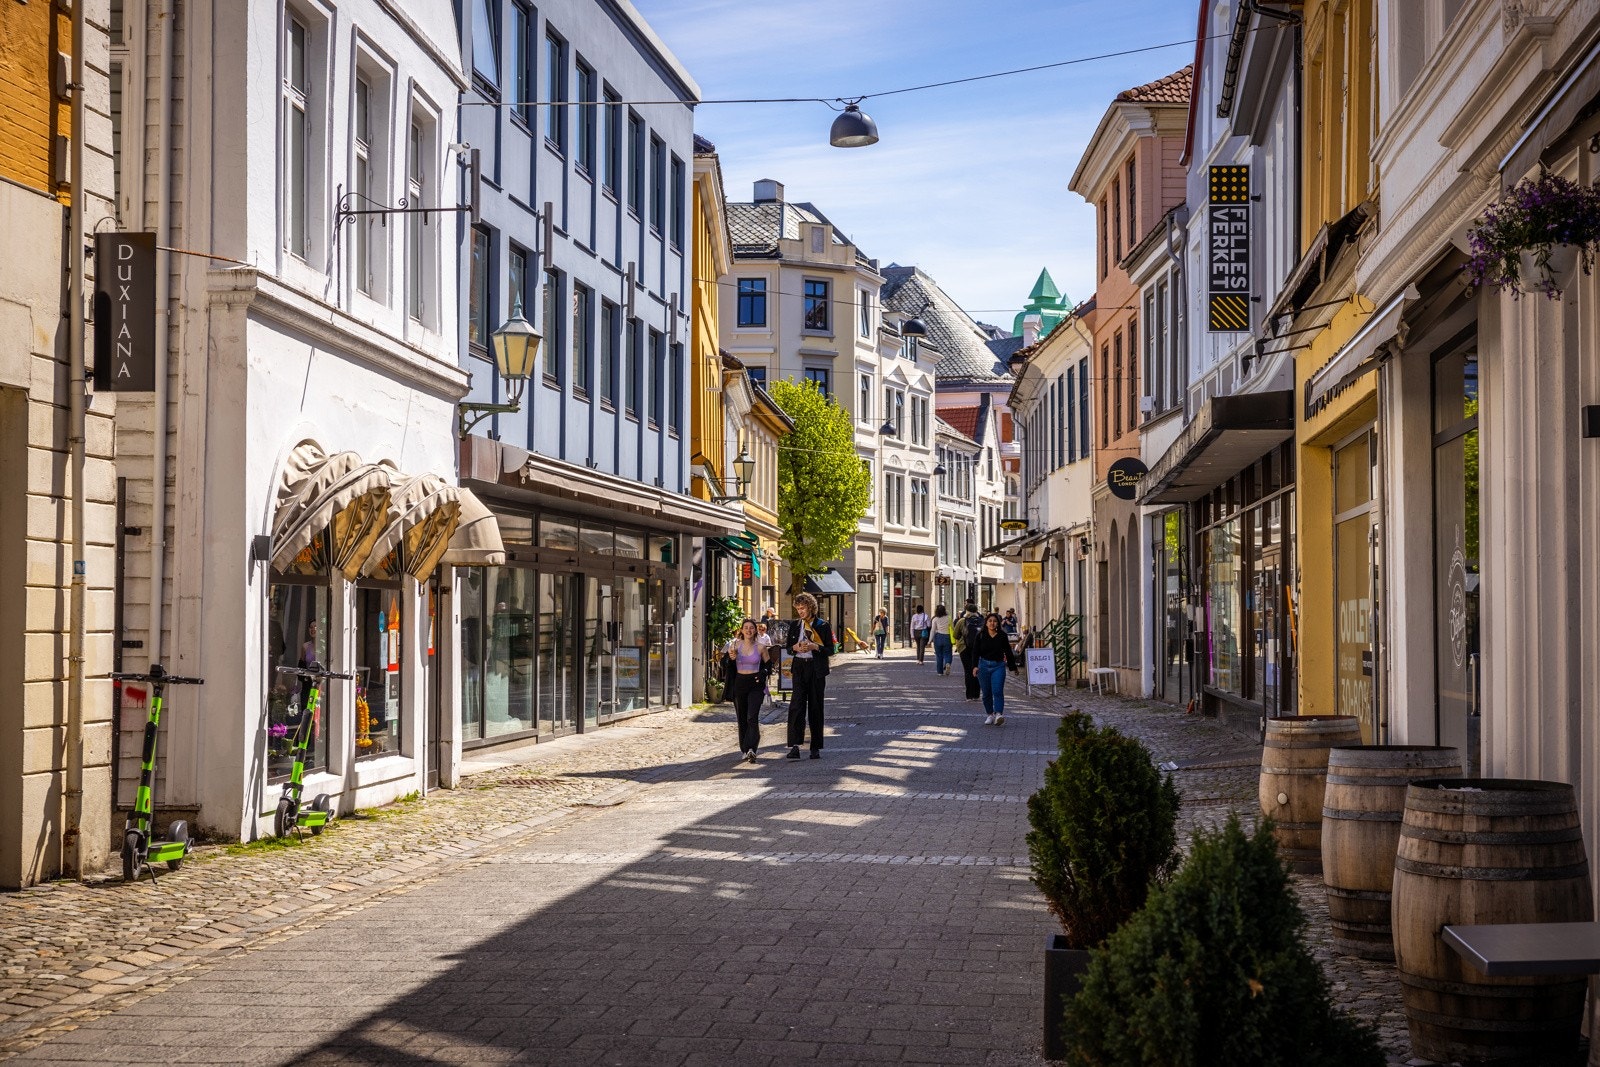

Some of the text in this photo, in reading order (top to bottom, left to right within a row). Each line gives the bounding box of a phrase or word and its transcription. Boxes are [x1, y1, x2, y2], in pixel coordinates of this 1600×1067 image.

[1212, 207, 1229, 289] VERKET
[1230, 208, 1247, 289] FELLES
[116, 244, 134, 378] DUXIANA
[1110, 469, 1144, 483] Beaut
[1341, 598, 1370, 643] OUTLET
